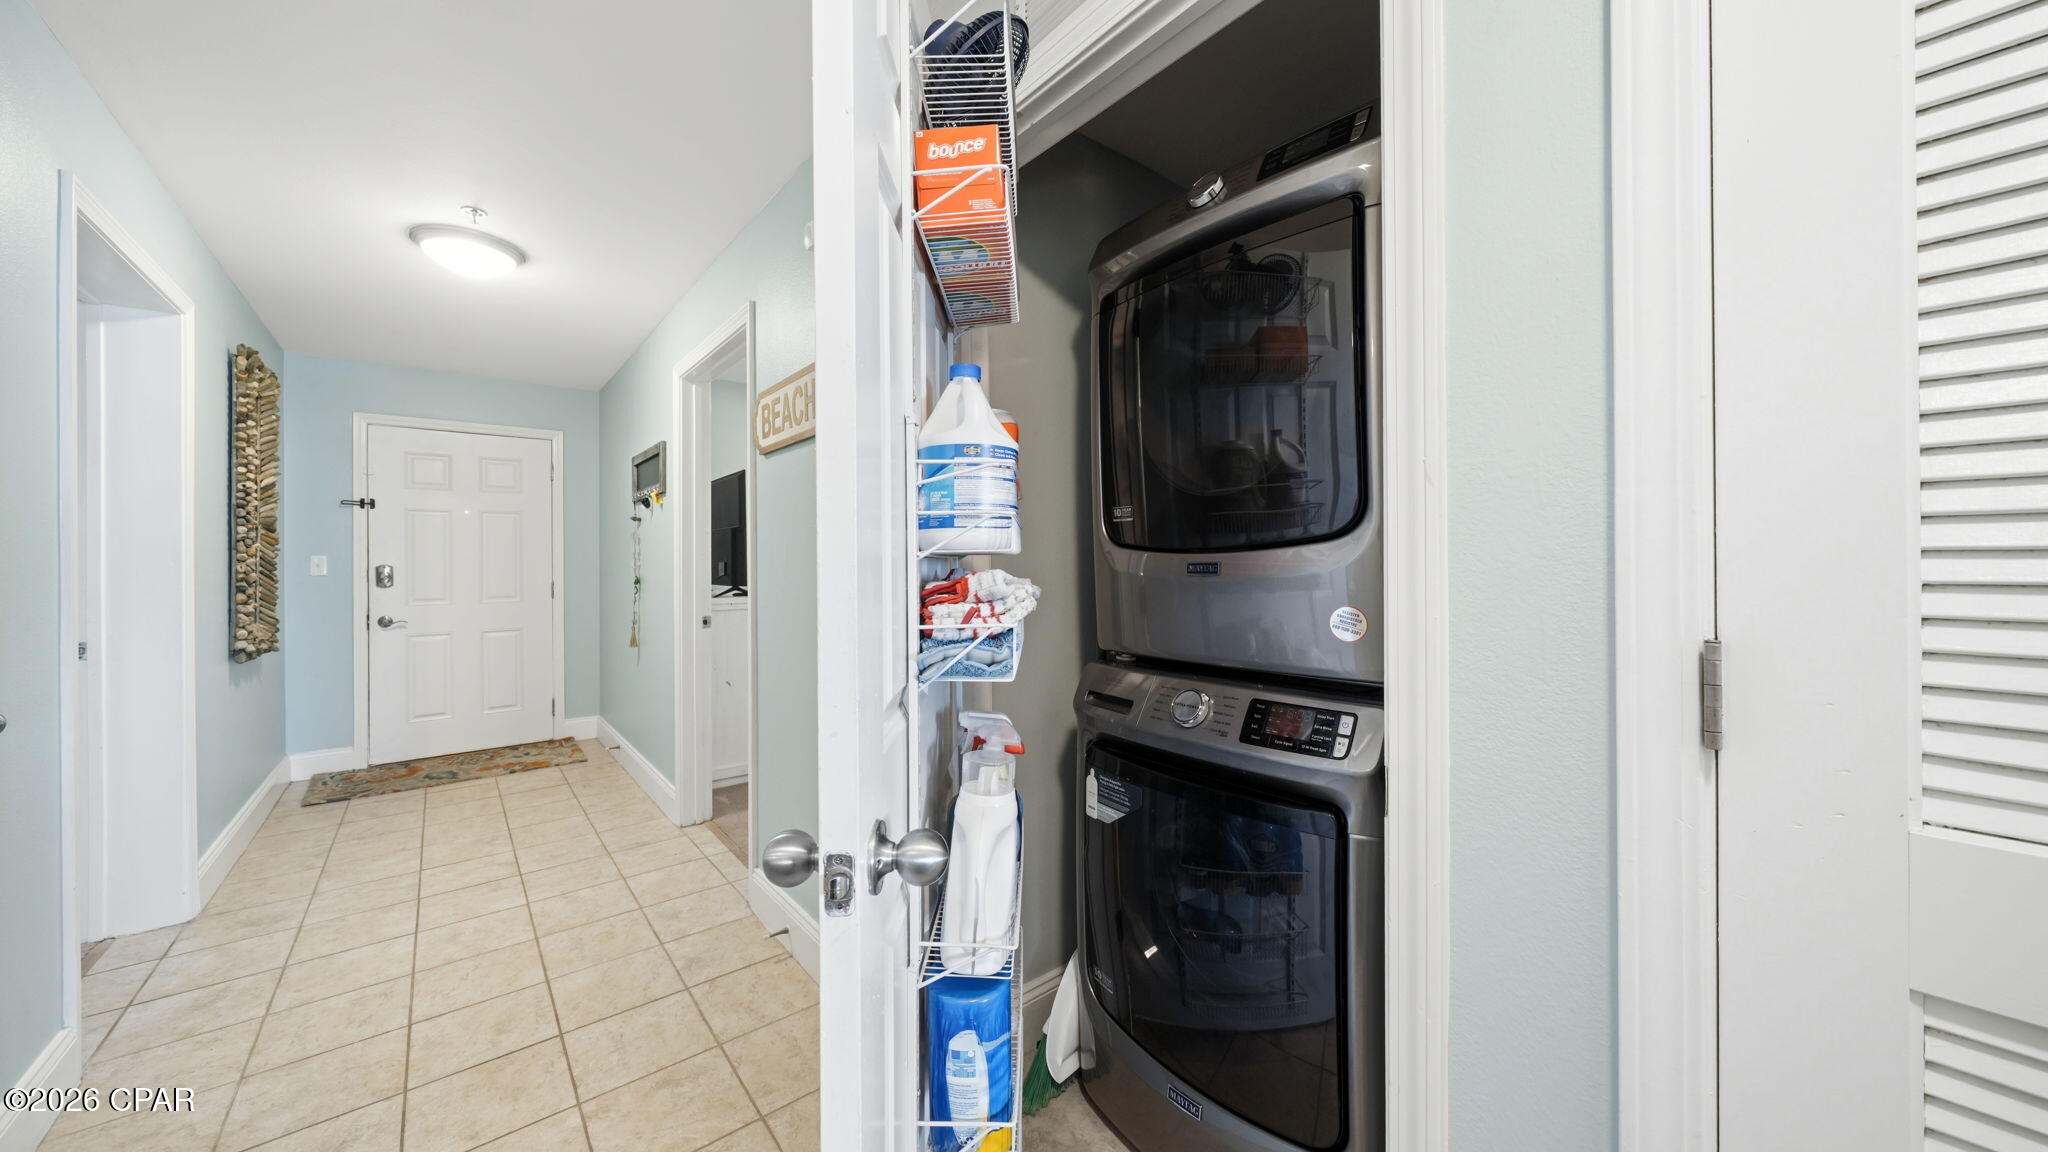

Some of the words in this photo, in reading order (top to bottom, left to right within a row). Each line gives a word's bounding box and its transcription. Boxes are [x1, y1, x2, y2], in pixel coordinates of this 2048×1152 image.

[927, 138, 987, 160] bounce
[761, 378, 816, 440] BEACH
[1169, 1089, 1199, 1117] MAYTAG
